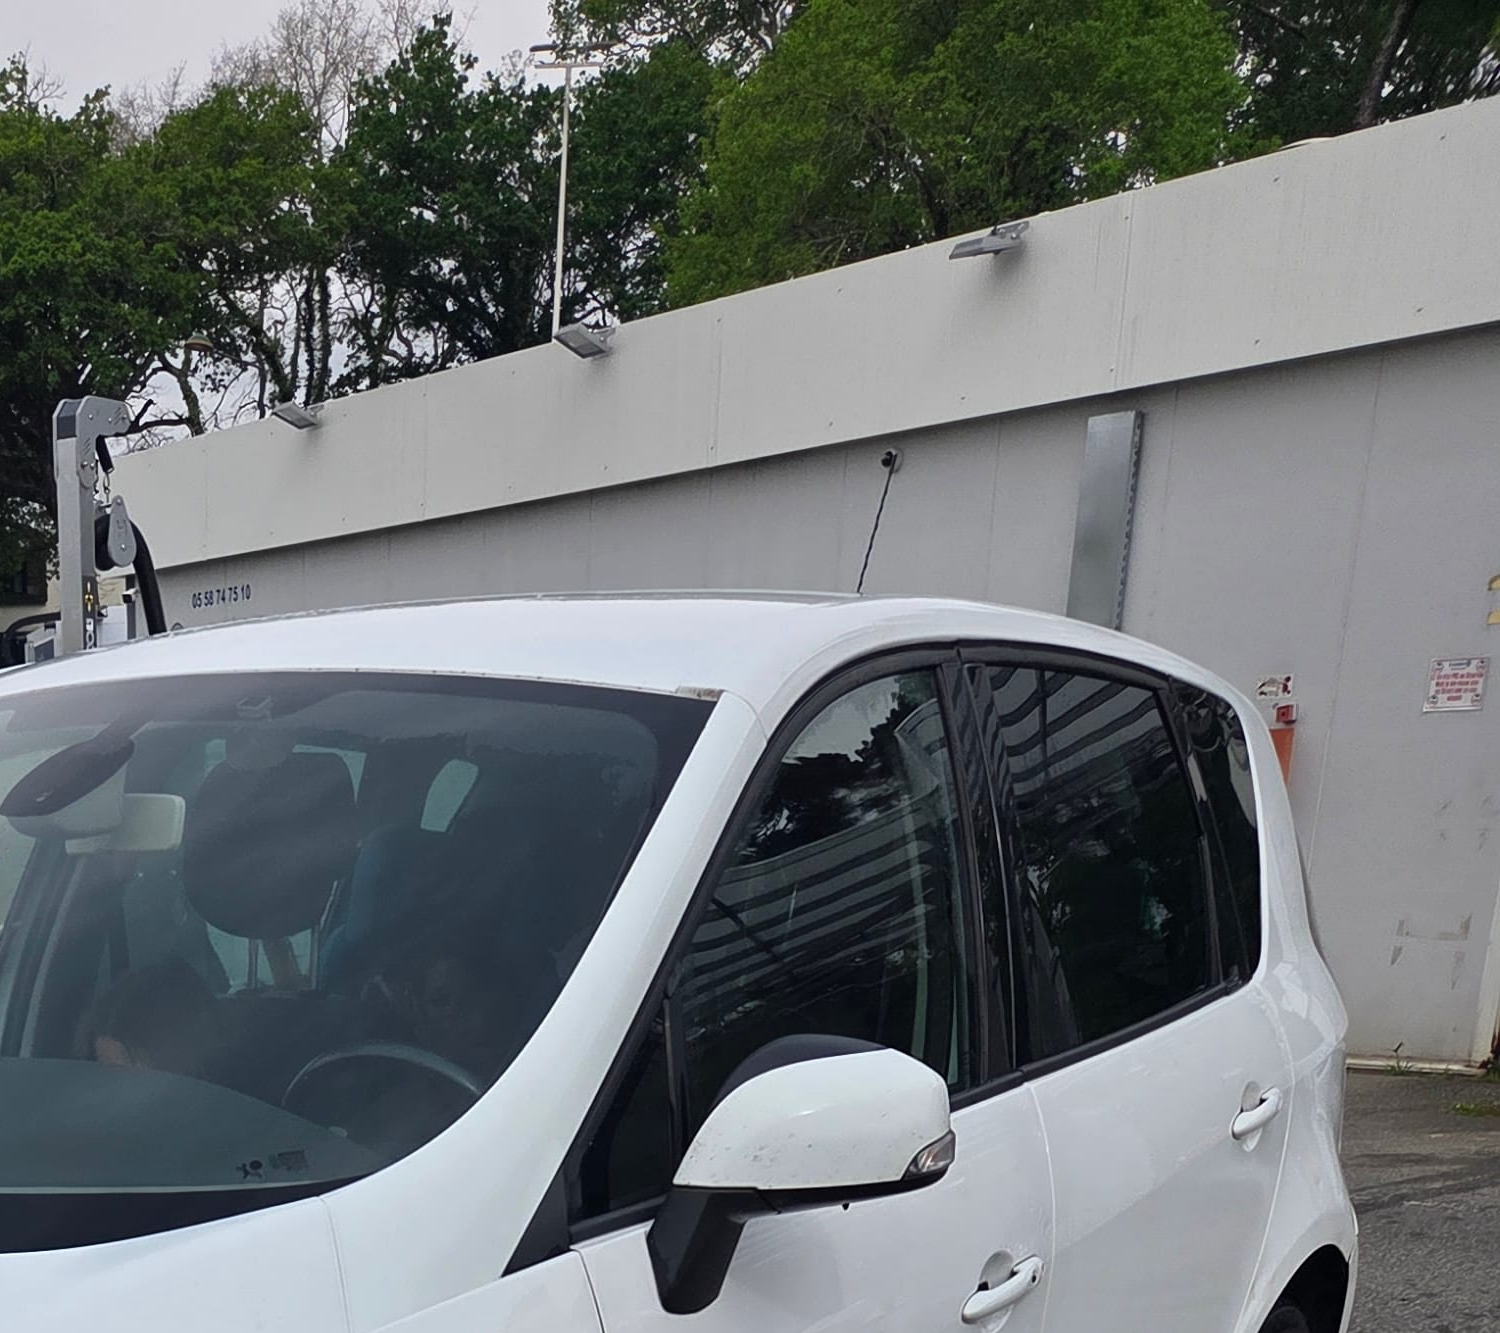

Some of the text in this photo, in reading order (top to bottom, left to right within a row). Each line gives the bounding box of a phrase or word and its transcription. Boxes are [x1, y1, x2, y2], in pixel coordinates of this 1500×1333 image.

[192, 592, 202, 608] 05
[216, 588, 225, 604] 74
[228, 585, 238, 602] 75
[241, 583, 251, 600] 10
